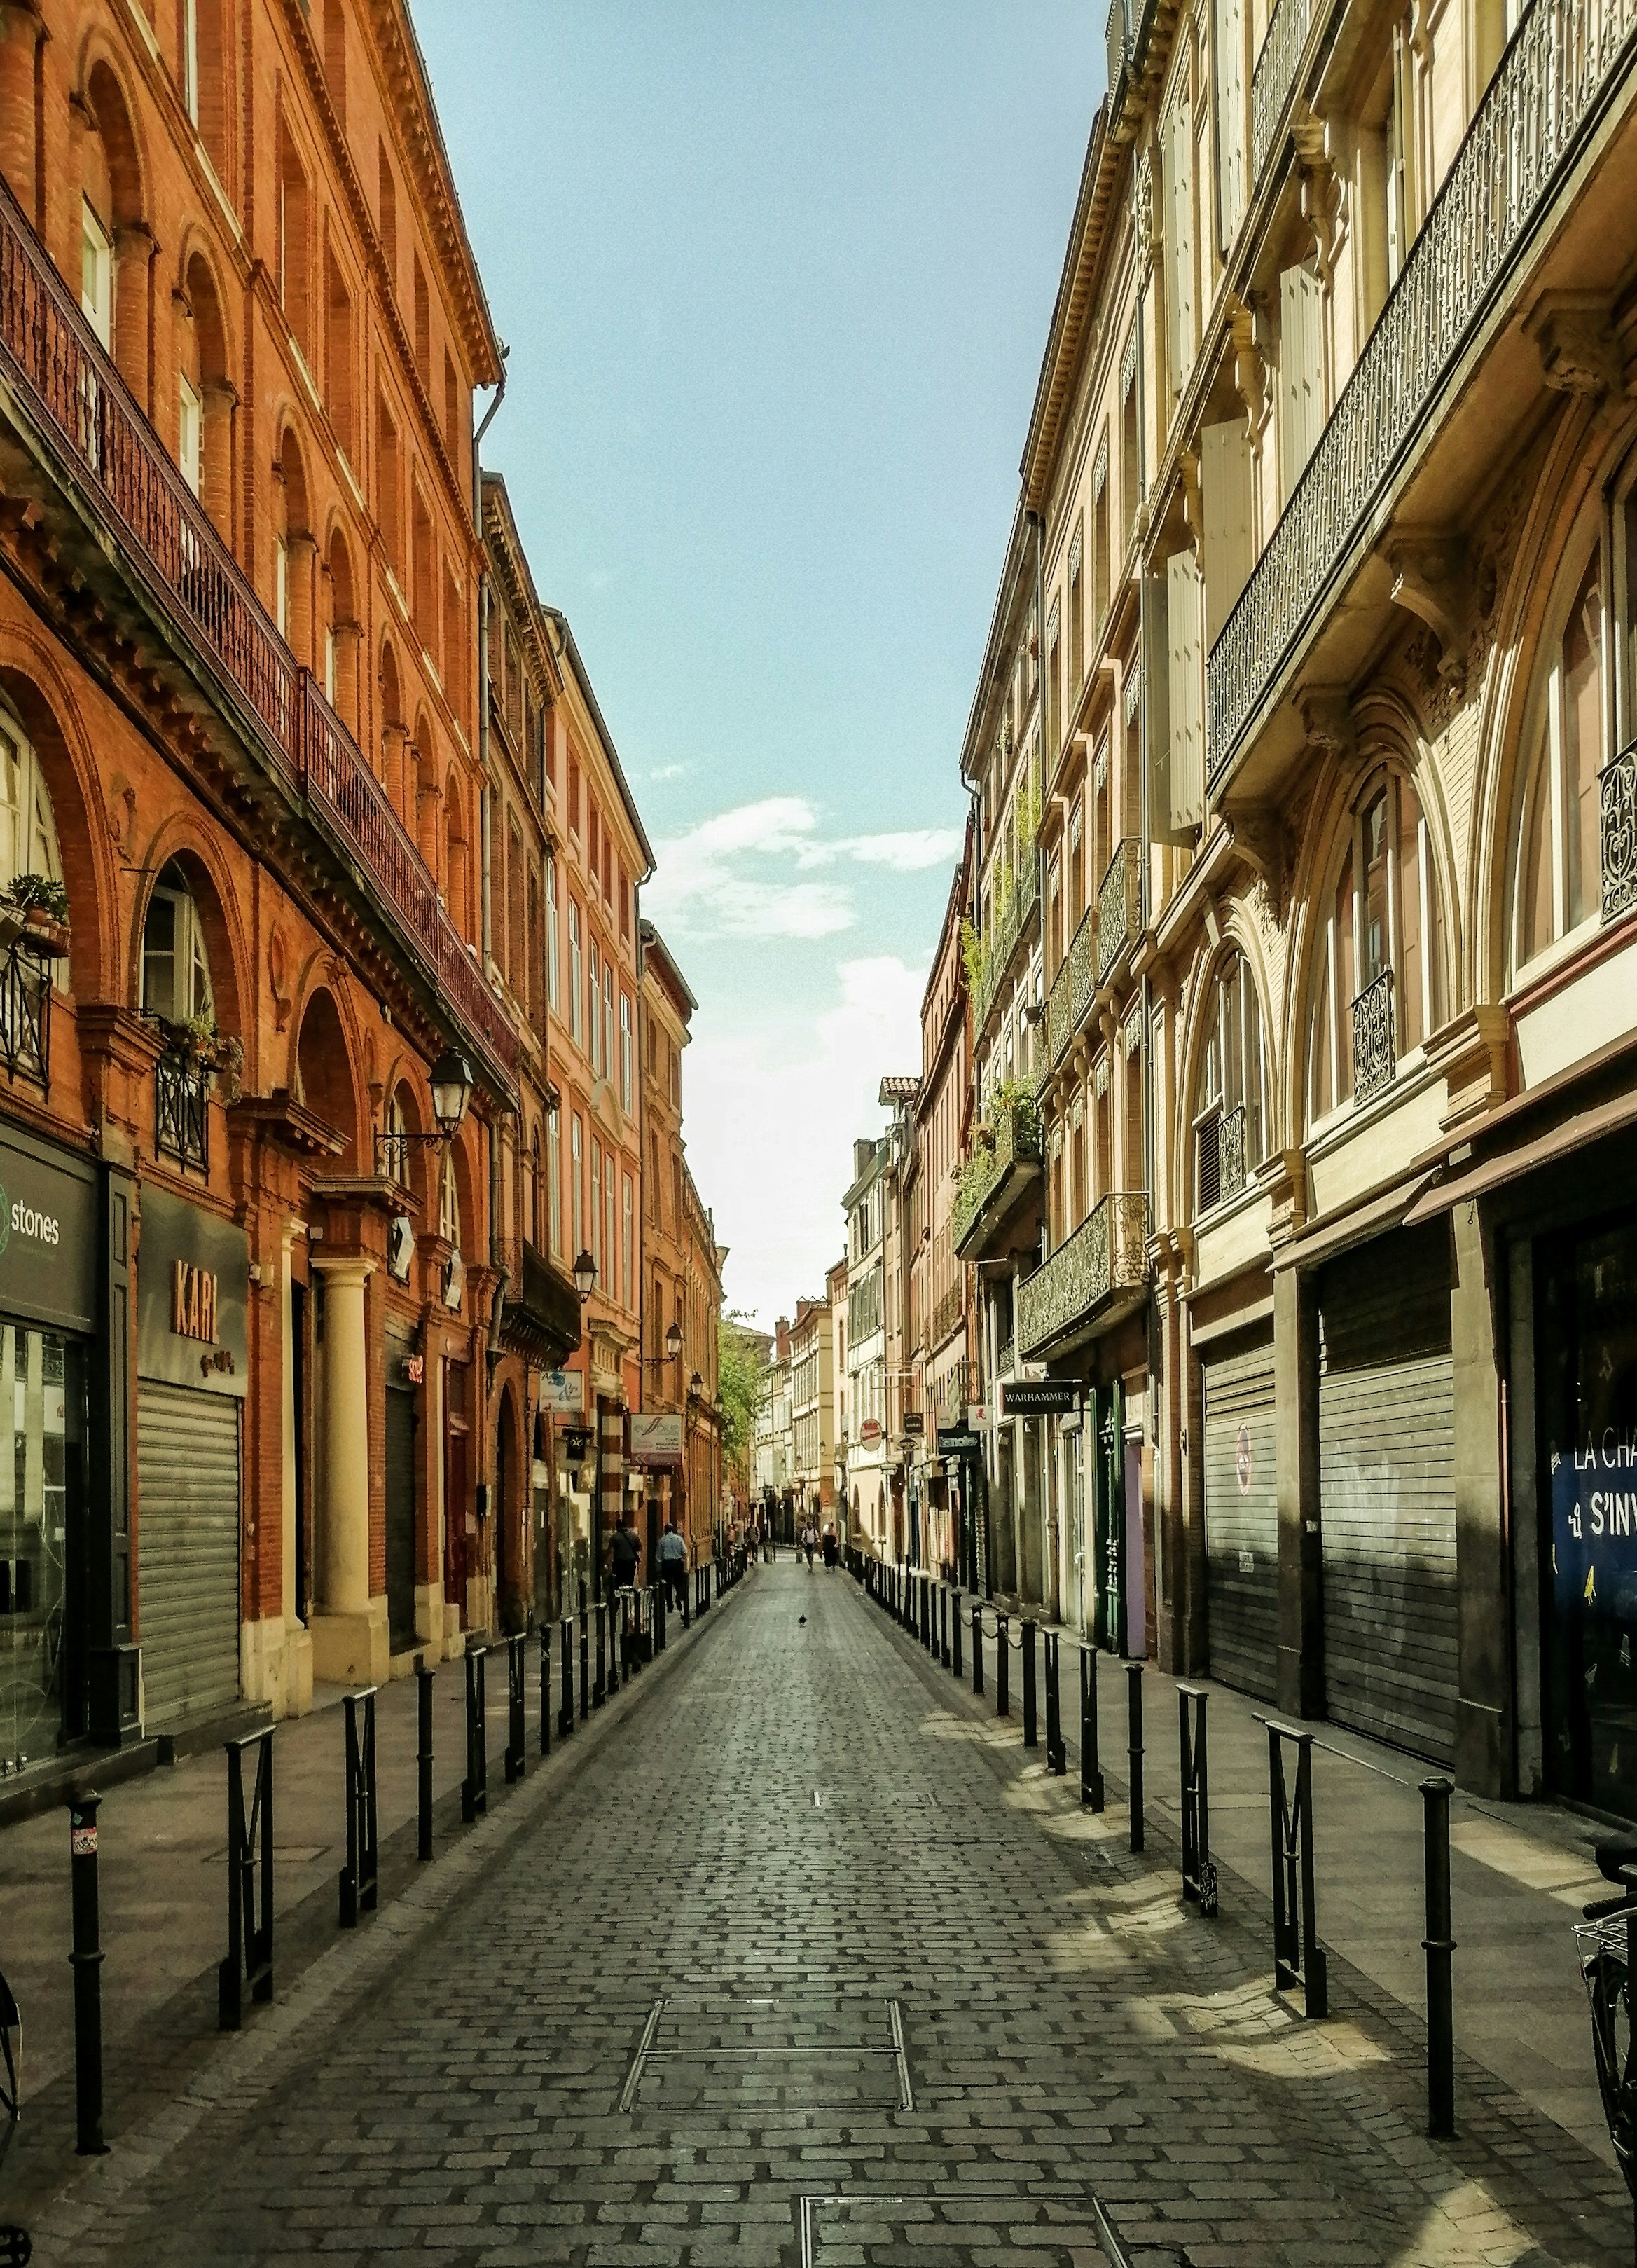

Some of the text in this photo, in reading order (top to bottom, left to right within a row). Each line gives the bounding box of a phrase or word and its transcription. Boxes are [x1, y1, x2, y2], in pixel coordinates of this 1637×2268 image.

[11, 1200, 59, 1245] stones
[176, 1260, 219, 1345] KARL
[1005, 1391, 1070, 1402] WARHAMMER
[1574, 1430, 1597, 1470] LA
